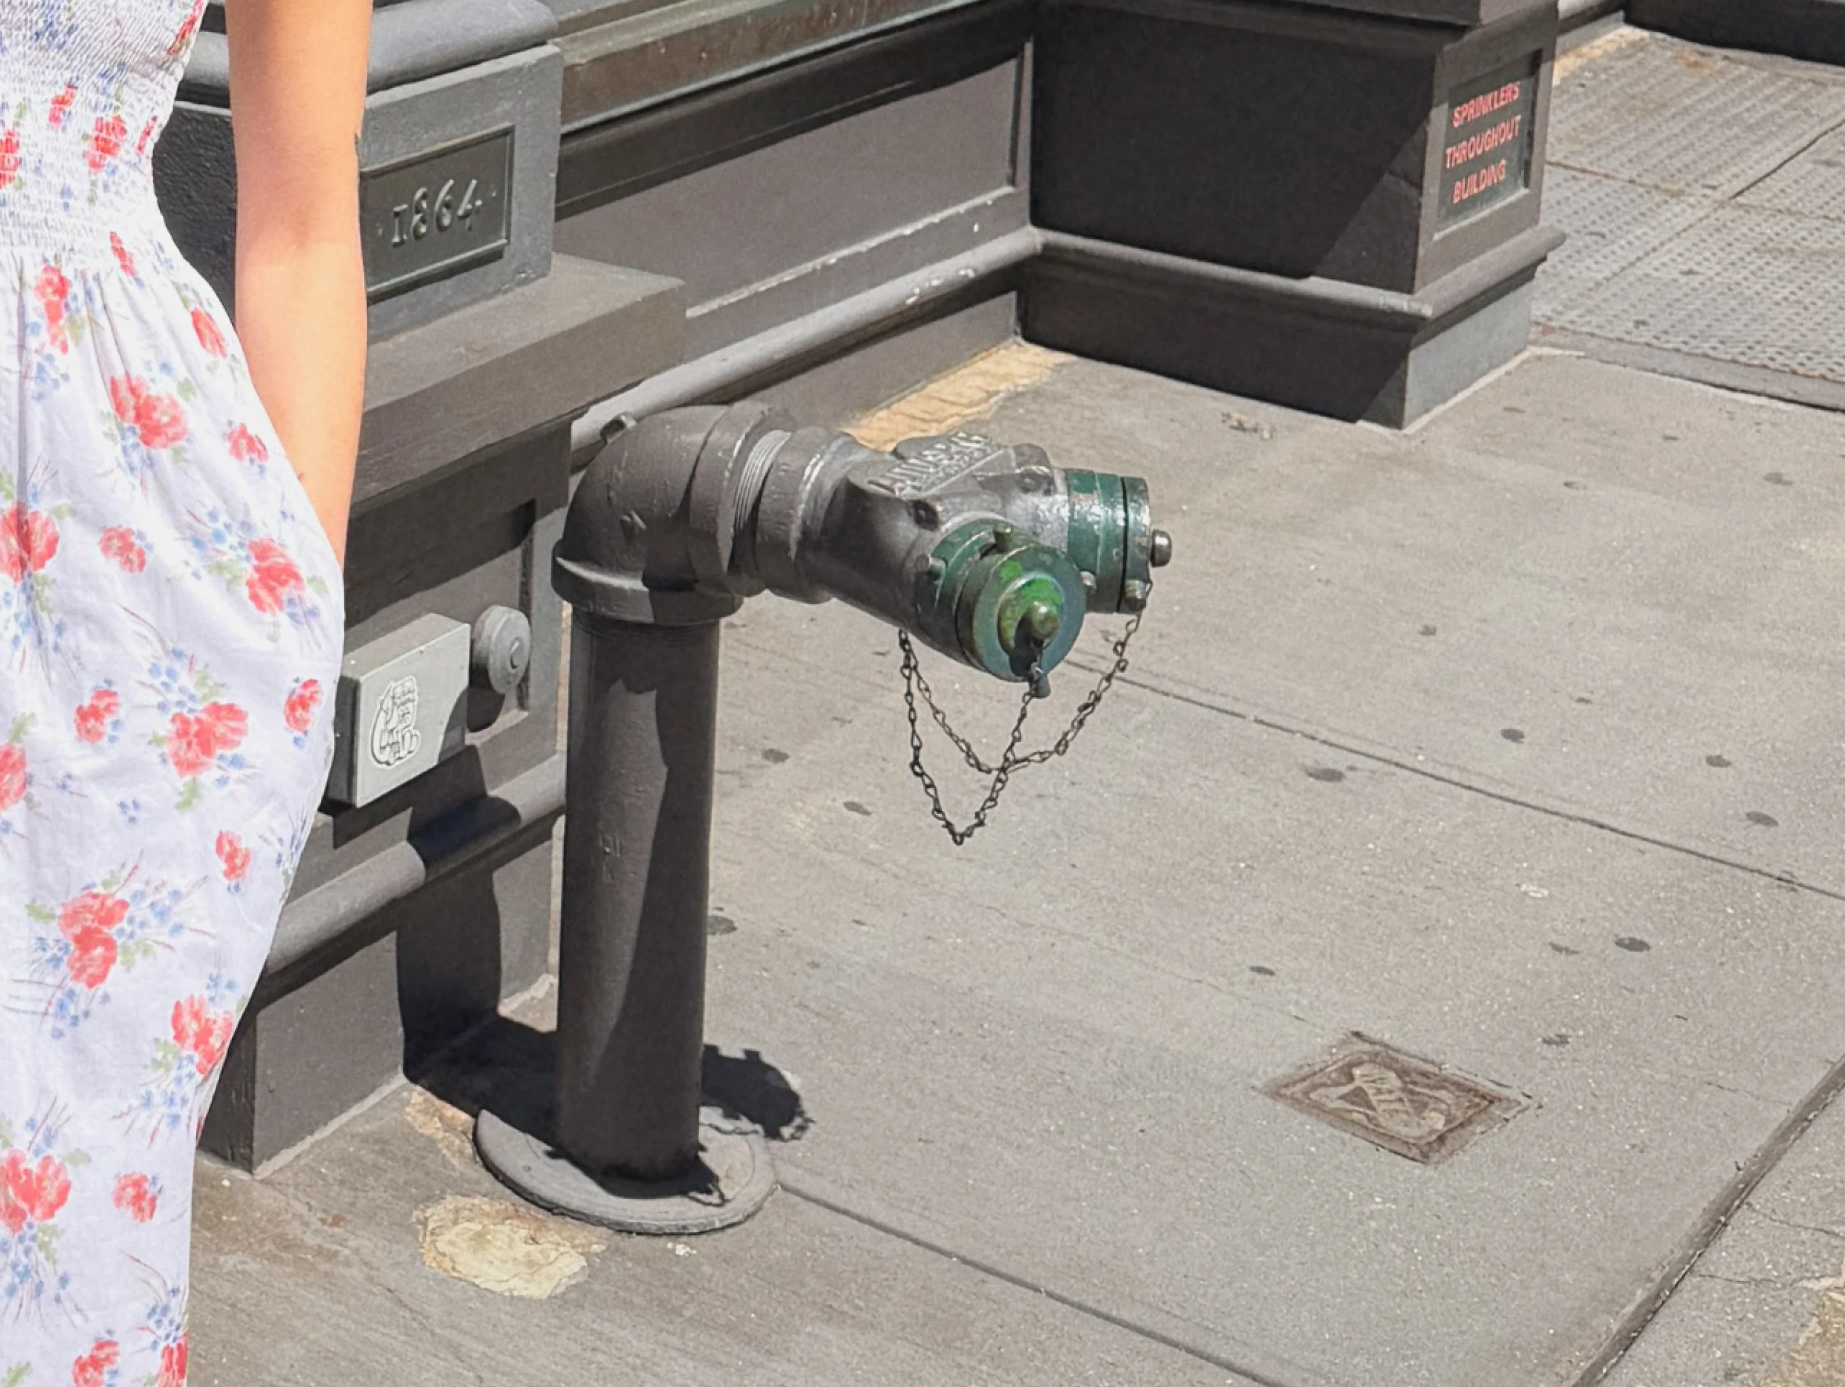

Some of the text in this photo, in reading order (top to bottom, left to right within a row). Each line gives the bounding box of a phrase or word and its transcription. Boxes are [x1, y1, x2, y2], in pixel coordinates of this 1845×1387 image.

[1452, 81, 1521, 128] SPRINKLERS
[1445, 115, 1522, 169] THROUGHOUT
[1452, 159, 1507, 204] BUILDING
[391, 179, 483, 248] 1864
